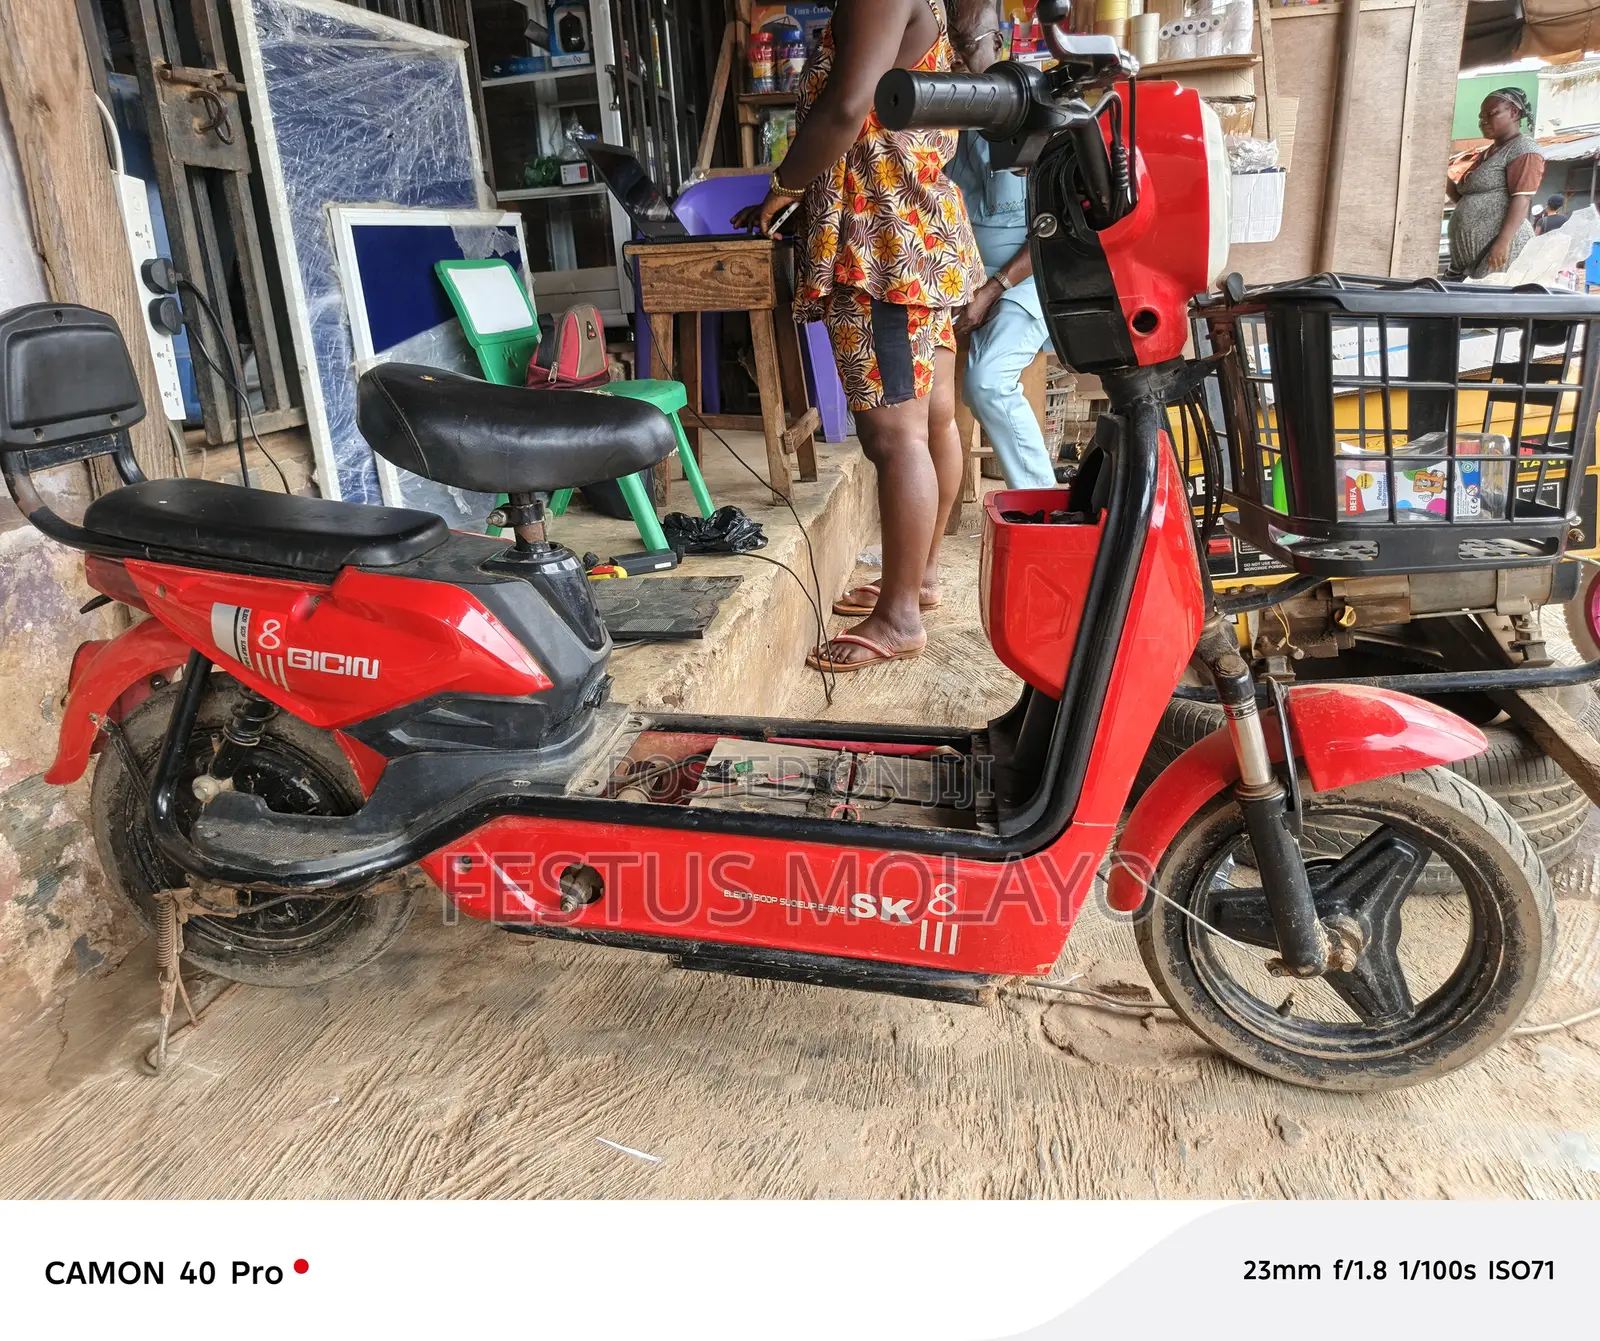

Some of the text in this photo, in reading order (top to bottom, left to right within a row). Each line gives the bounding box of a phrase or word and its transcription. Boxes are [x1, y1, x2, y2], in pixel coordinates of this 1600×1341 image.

[1349, 487, 1357, 512] BEIFA
[287, 647, 380, 680] GICIN
[849, 893, 914, 924] SK
